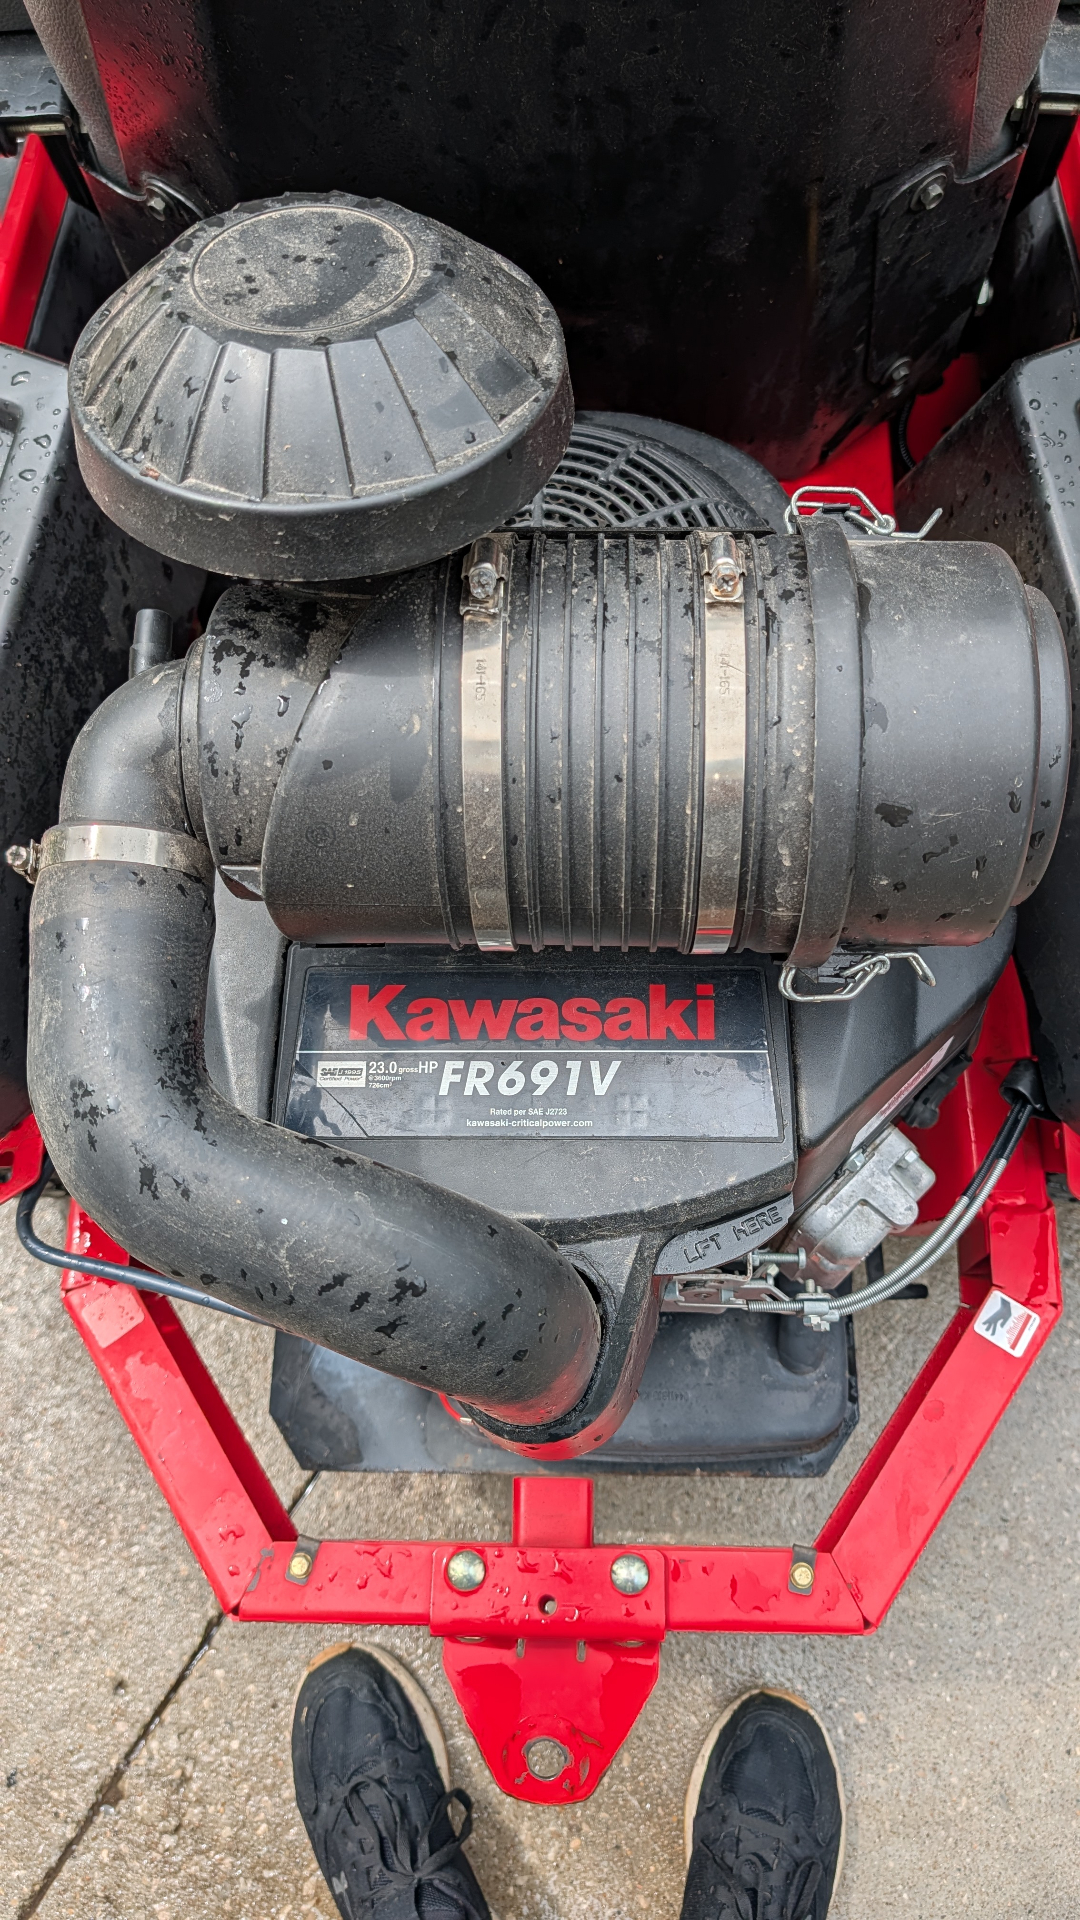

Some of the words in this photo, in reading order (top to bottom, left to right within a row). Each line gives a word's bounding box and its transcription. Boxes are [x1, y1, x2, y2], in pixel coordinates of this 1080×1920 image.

[348, 983, 716, 1042] Kawasaki
[368, 1061, 398, 1074] 23.0
[398, 1067, 419, 1075] gross
[418, 1060, 439, 1074] HP
[438, 1059, 623, 1097] FR691V
[466, 1118, 593, 1129] kawasaki-criticalpower.com
[489, 1107, 512, 1116] Rated
[513, 1108, 527, 1117] per
[527, 1107, 544, 1116] SAE
[545, 1107, 568, 1116] J2723
[731, 1205, 783, 1242] HERE
